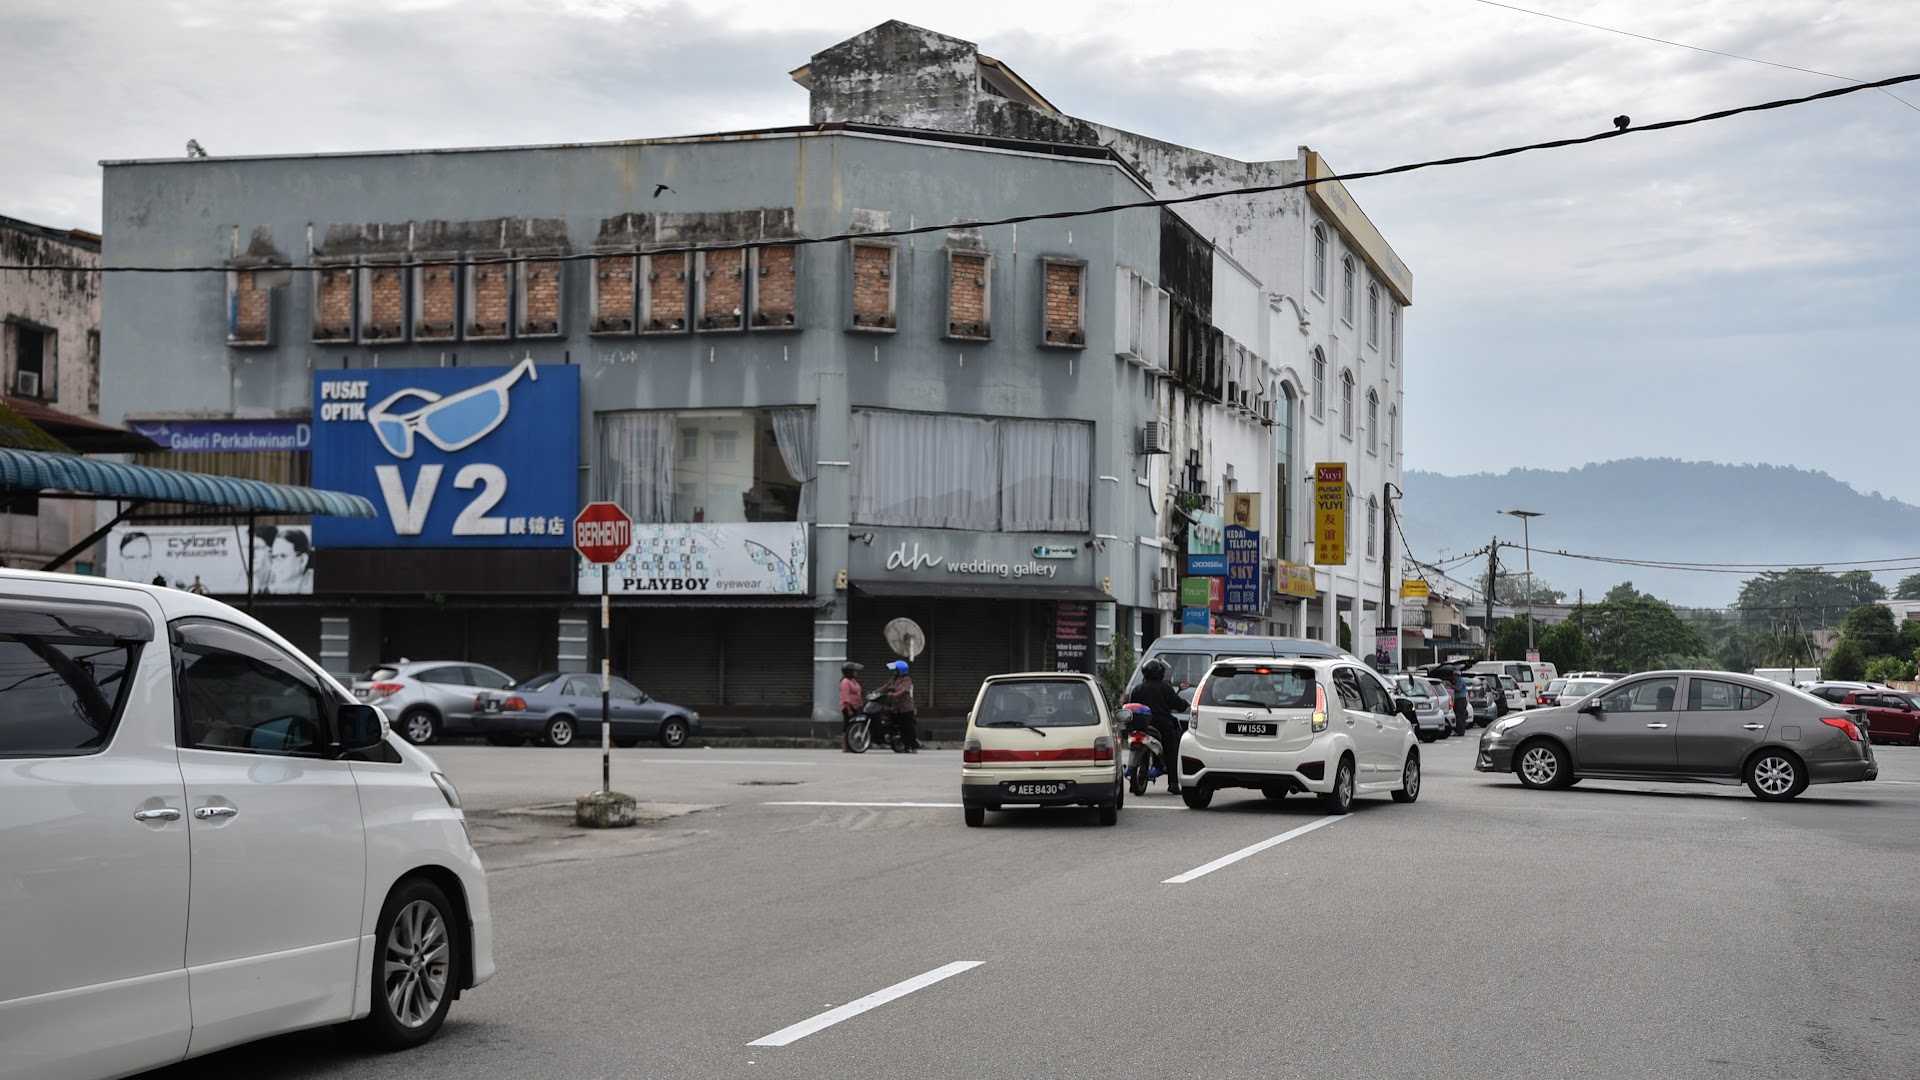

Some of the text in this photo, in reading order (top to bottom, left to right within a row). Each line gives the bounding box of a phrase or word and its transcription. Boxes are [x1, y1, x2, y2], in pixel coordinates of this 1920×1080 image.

[321, 381, 369, 400] PUSAT
[321, 402, 366, 421] OPTIK
[170, 432, 209, 449] Galeri
[212, 432, 295, 449] Perkahwinan
[1318, 501, 1342, 510] YUYI
[577, 520, 629, 547] BERHENTI
[1226, 529, 1246, 539] KEDAI
[1229, 540, 1257, 549] TELEFON
[886, 542, 1057, 578] dh wedding gallery
[1226, 550, 1257, 563] BLUE
[1230, 566, 1253, 579] SKY
[622, 578, 761, 591] PLAYBOY eyewear
[1227, 580, 1243, 590] phone
[1244, 580, 1257, 590] shop
[1237, 724, 1266, 733] VM 1553
[1018, 785, 1057, 795] AEE 8430
